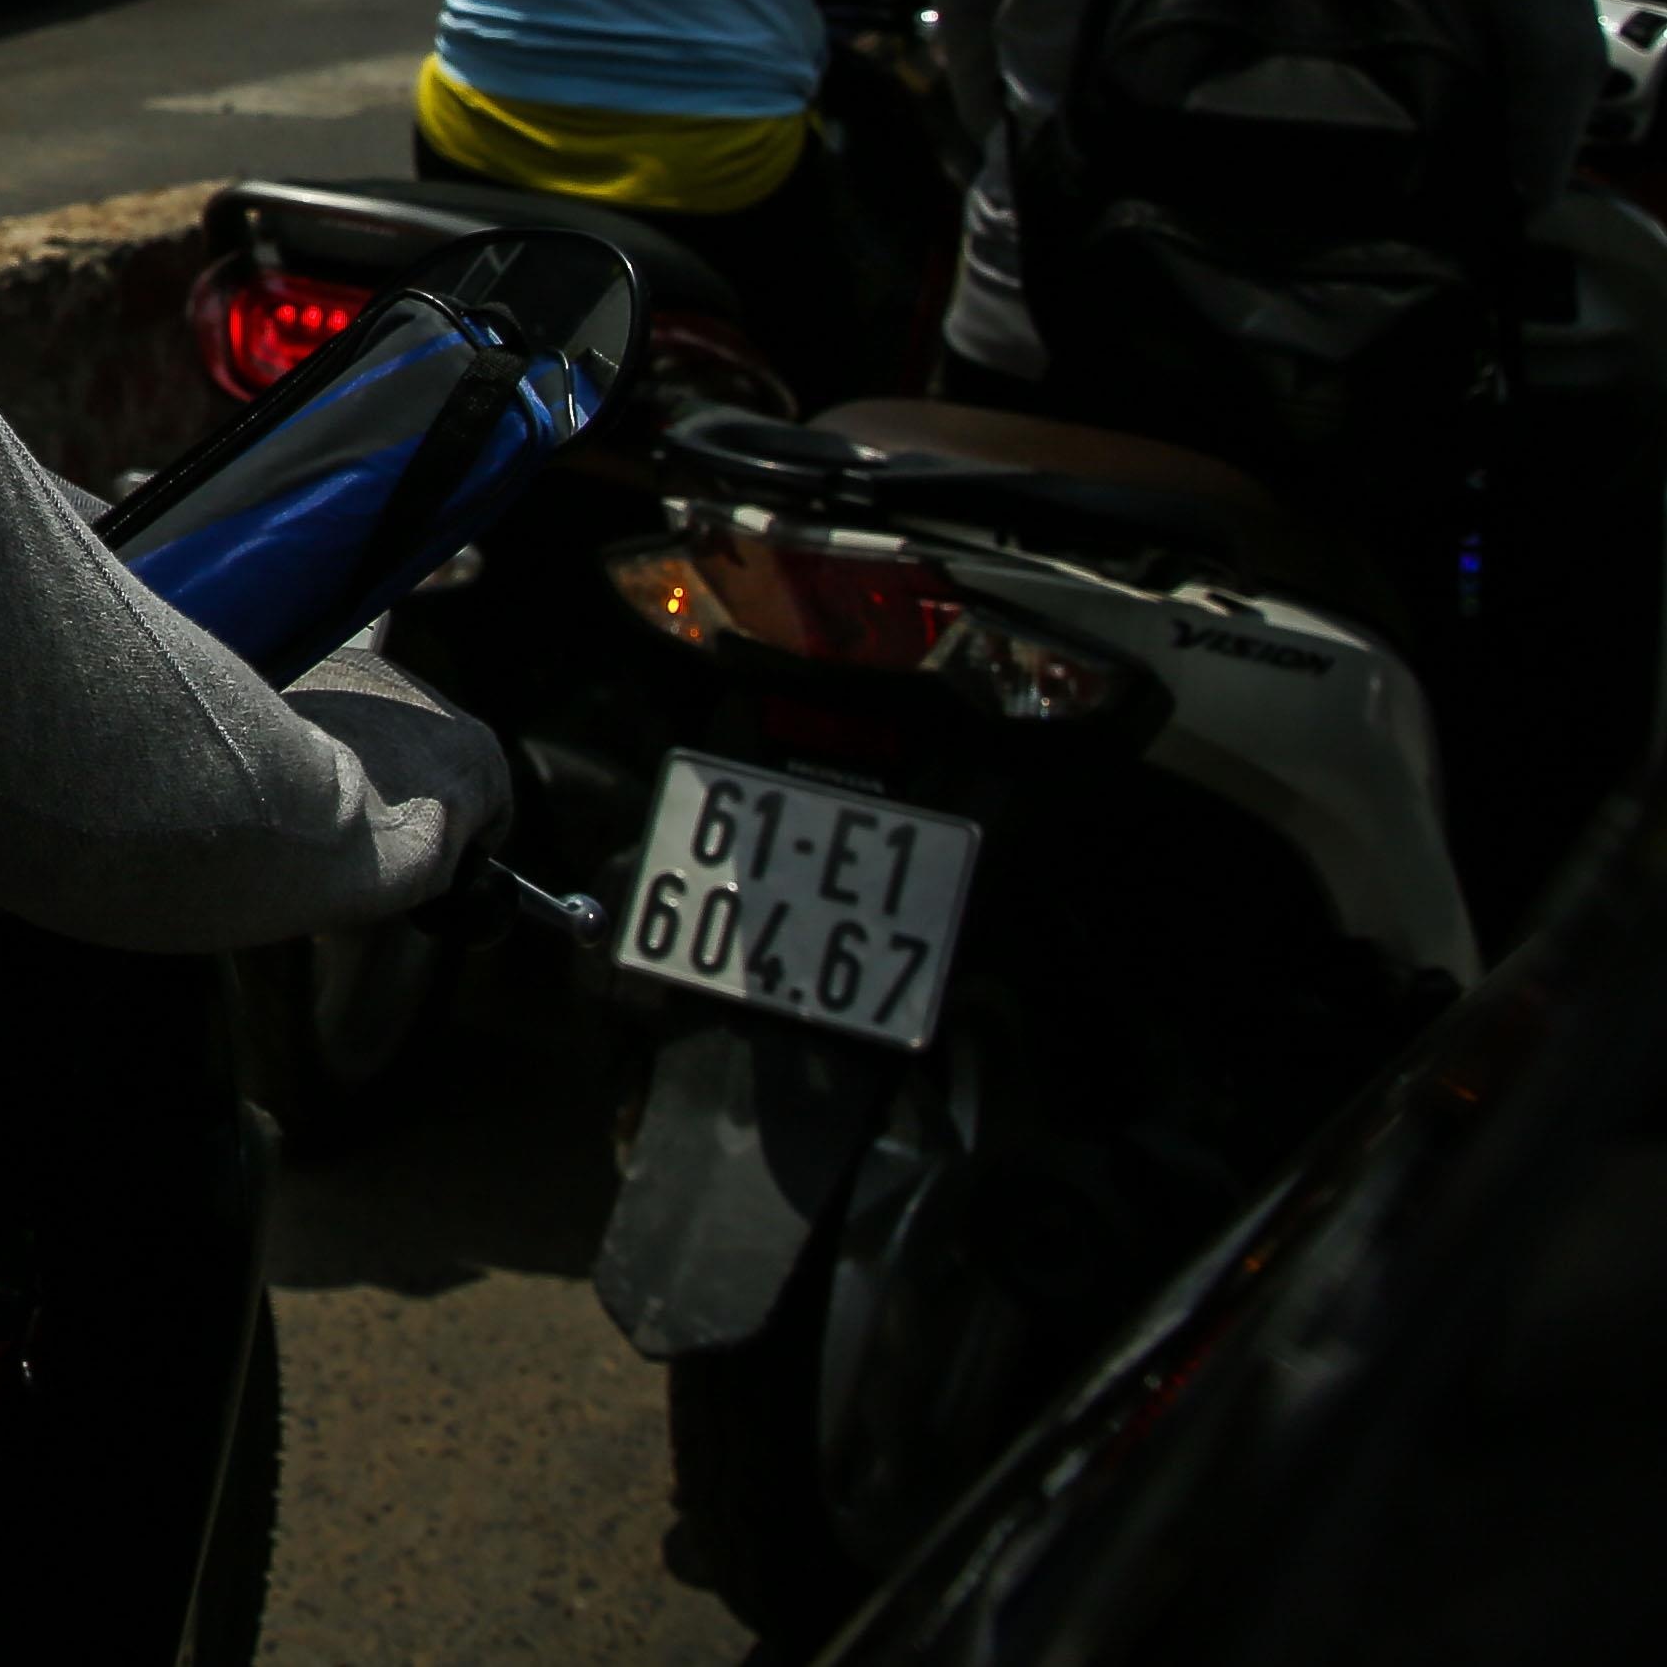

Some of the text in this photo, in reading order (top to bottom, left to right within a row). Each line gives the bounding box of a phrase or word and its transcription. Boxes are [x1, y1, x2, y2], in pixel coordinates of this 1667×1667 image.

[1172, 617, 1337, 678] VISION
[691, 779, 918, 916] 61-E1
[636, 871, 930, 1024] 604.67
